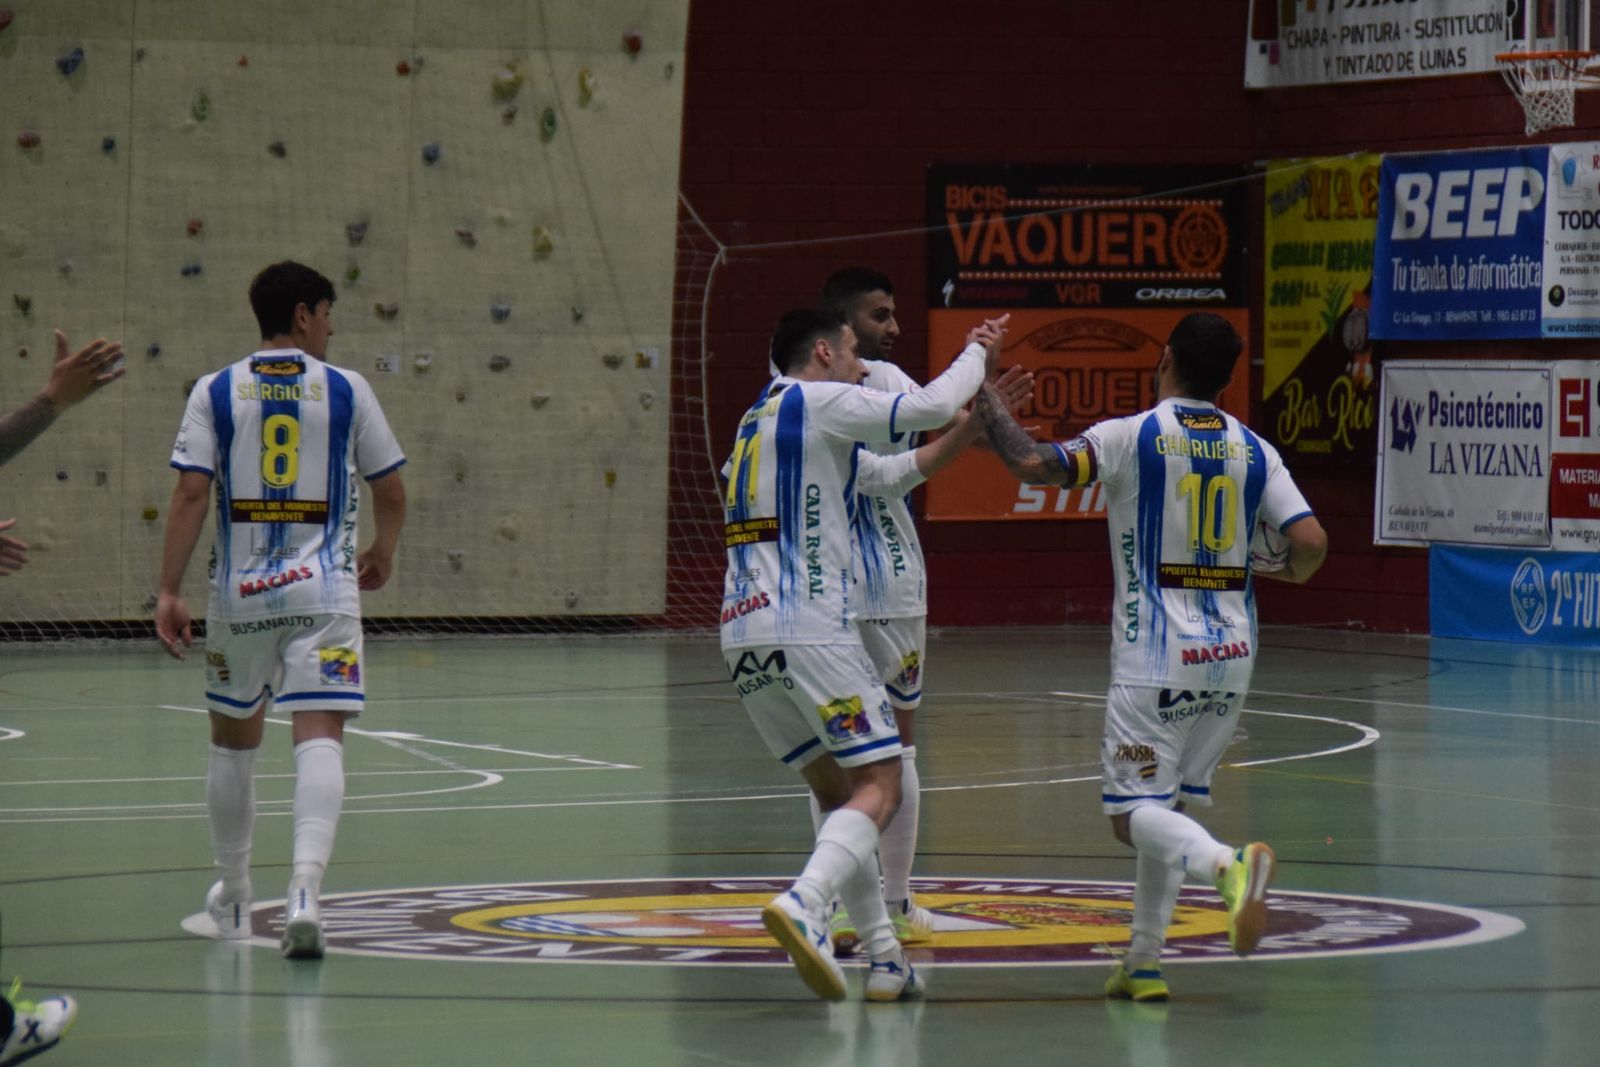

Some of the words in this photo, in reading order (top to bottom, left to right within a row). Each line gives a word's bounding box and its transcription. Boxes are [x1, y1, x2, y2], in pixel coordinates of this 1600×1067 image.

[1287, 29, 1328, 49] CHAPA
[1341, 23, 1400, 46] PINTURA
[1323, 58, 1332, 77] Y
[1336, 51, 1393, 75] TINTADO
[1397, 52, 1414, 73] DE
[1420, 47, 1467, 70] LUNAS
[945, 185, 1007, 210] BICIS
[1391, 166, 1545, 241] BEEP
[1392, 257, 1408, 291] Tu
[1410, 256, 1448, 292] tienda
[1451, 256, 1466, 291] de
[1136, 288, 1227, 300] ORBEA
[1429, 390, 1543, 430] Psicotécnico
[261, 413, 301, 490] 8
[1460, 442, 1543, 478] VIZANA
[805, 483, 821, 532] CAJA
[1176, 473, 1238, 553] 10
[230, 616, 314, 635] BUSANAUTO
[1181, 641, 1249, 665] MACIAS
